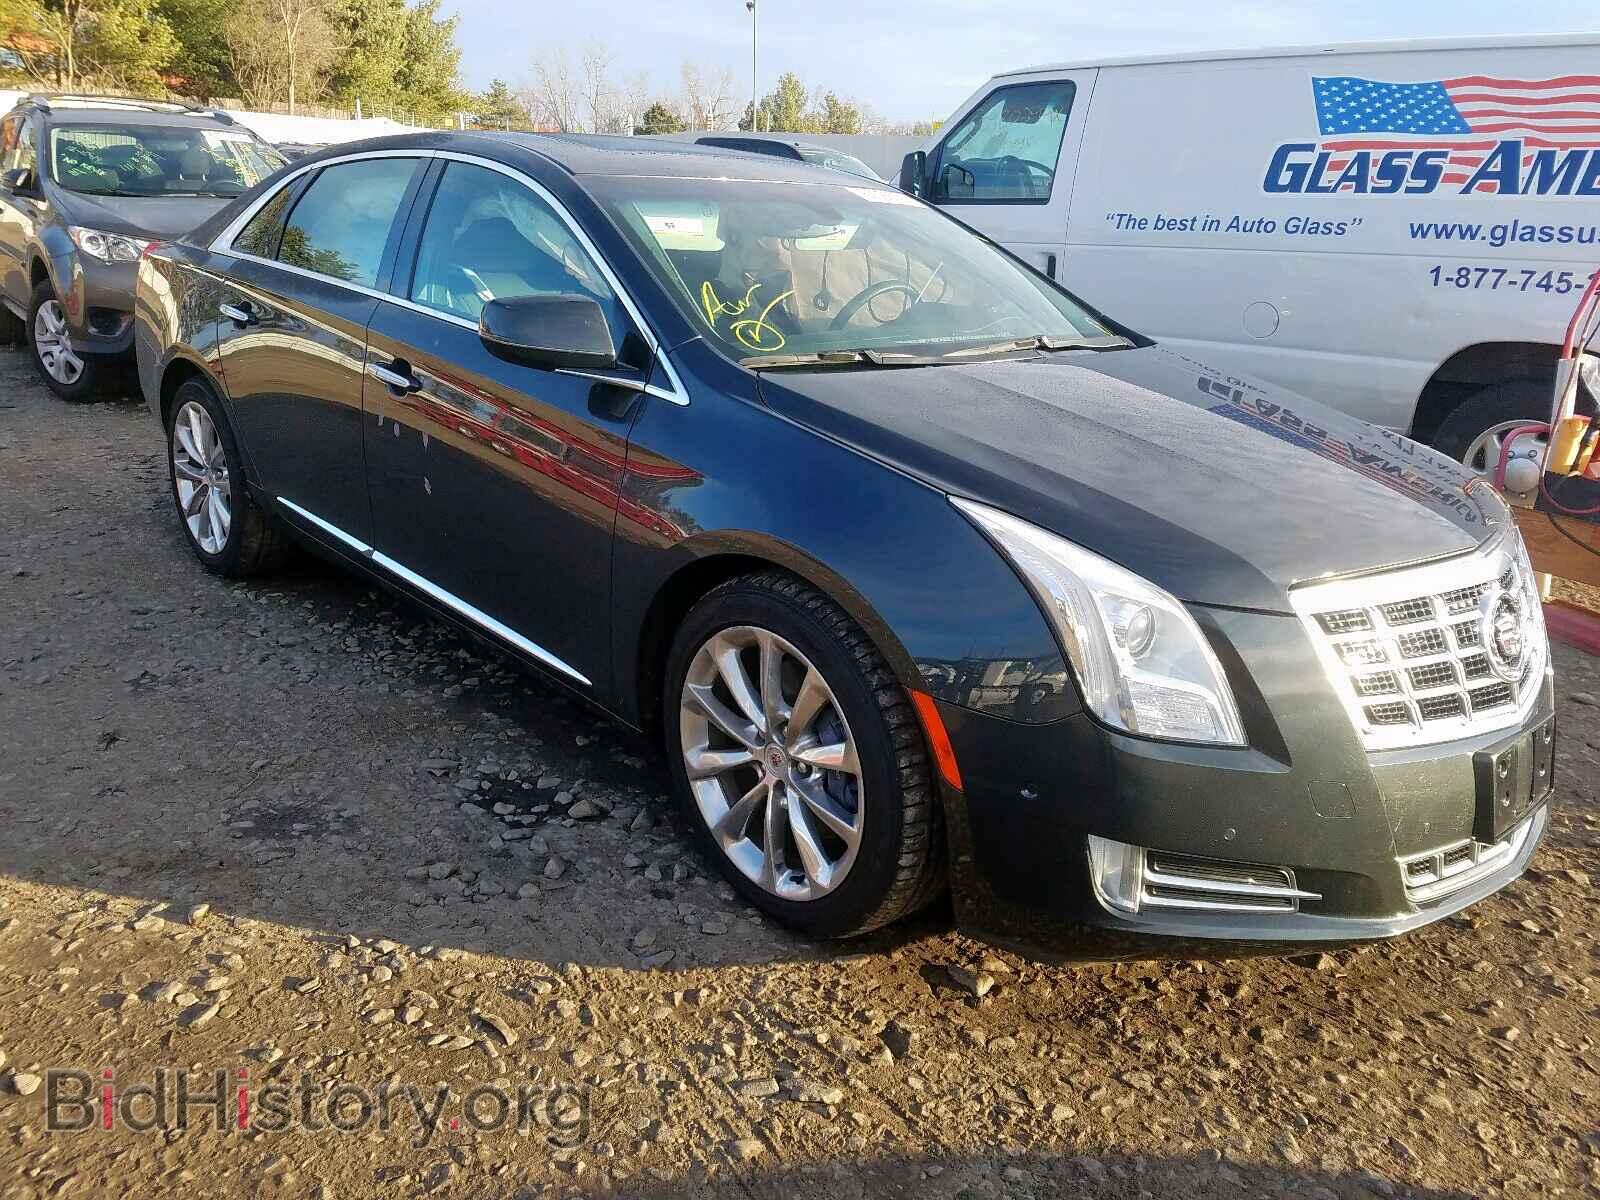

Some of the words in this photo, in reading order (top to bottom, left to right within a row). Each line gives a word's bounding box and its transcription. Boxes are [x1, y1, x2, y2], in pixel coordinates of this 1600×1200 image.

[1263, 142, 1449, 194] GLASS
[1153, 214, 1197, 232] best
[1201, 214, 1220, 232] in
[1225, 215, 1277, 234] Auto
[1409, 219, 1600, 248] www.glassu
